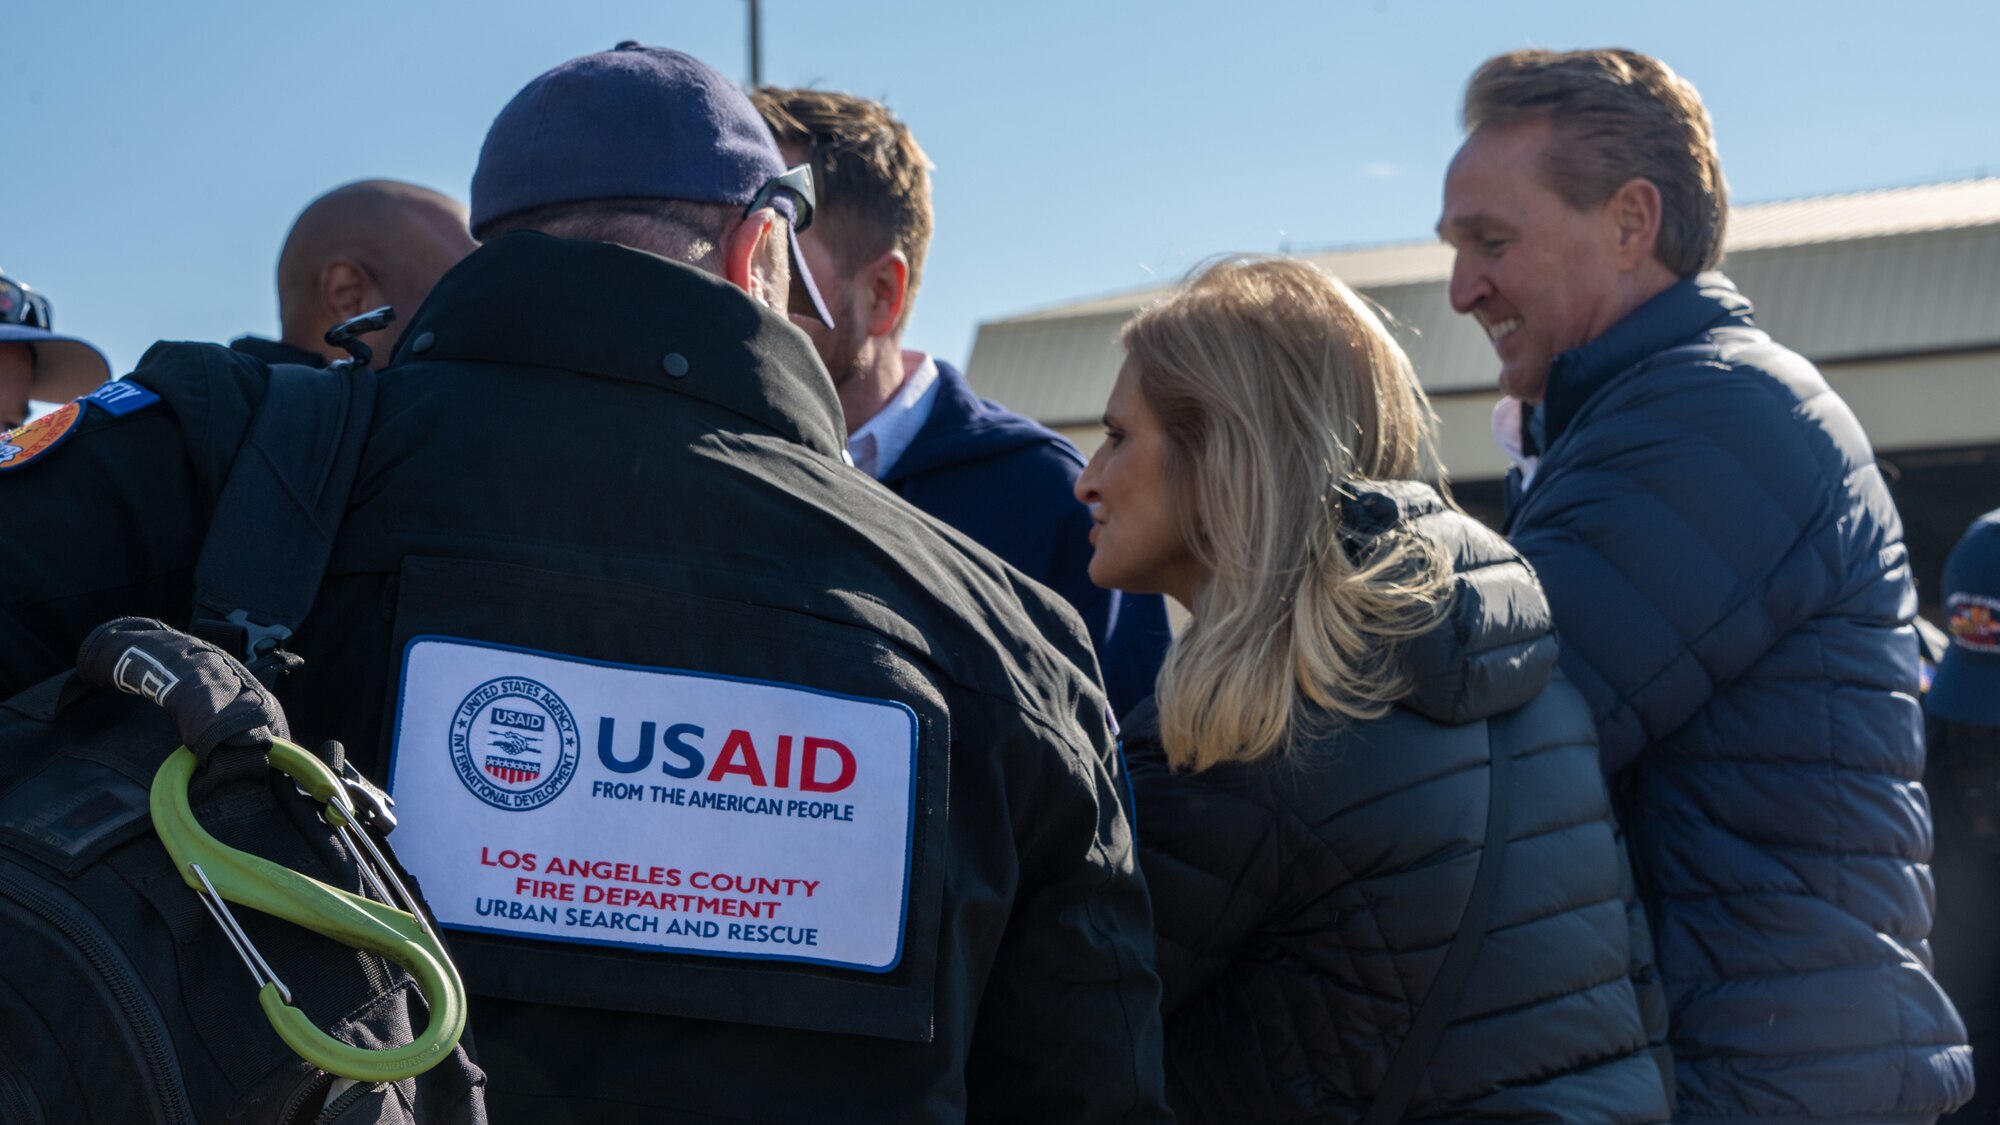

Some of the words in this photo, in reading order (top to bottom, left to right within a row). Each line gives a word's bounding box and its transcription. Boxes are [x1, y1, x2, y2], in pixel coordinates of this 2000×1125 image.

[462, 684, 499, 717] UNITED
[500, 680, 542, 698] STATES
[540, 692, 574, 733] AGENCY
[495, 710, 543, 729] USAID
[453, 733, 512, 807] INTERNATIONAL
[514, 752, 575, 807] DEVELOPMENT
[597, 716, 857, 794] USAID
[592, 780, 644, 801] FROM
[649, 785, 686, 806] THE
[688, 790, 783, 816] AMERICAN
[787, 800, 854, 822] PEOPLE
[480, 846, 537, 872] LOS
[544, 857, 682, 887] ANGELES
[689, 871, 820, 899] COUNTY
[515, 877, 576, 902] FIRE
[583, 884, 782, 919] DEPARTMENT
[475, 897, 558, 925] URBAN
[565, 907, 659, 933] SEARCH
[665, 918, 720, 939] AND
[727, 923, 818, 946] RESCUE
